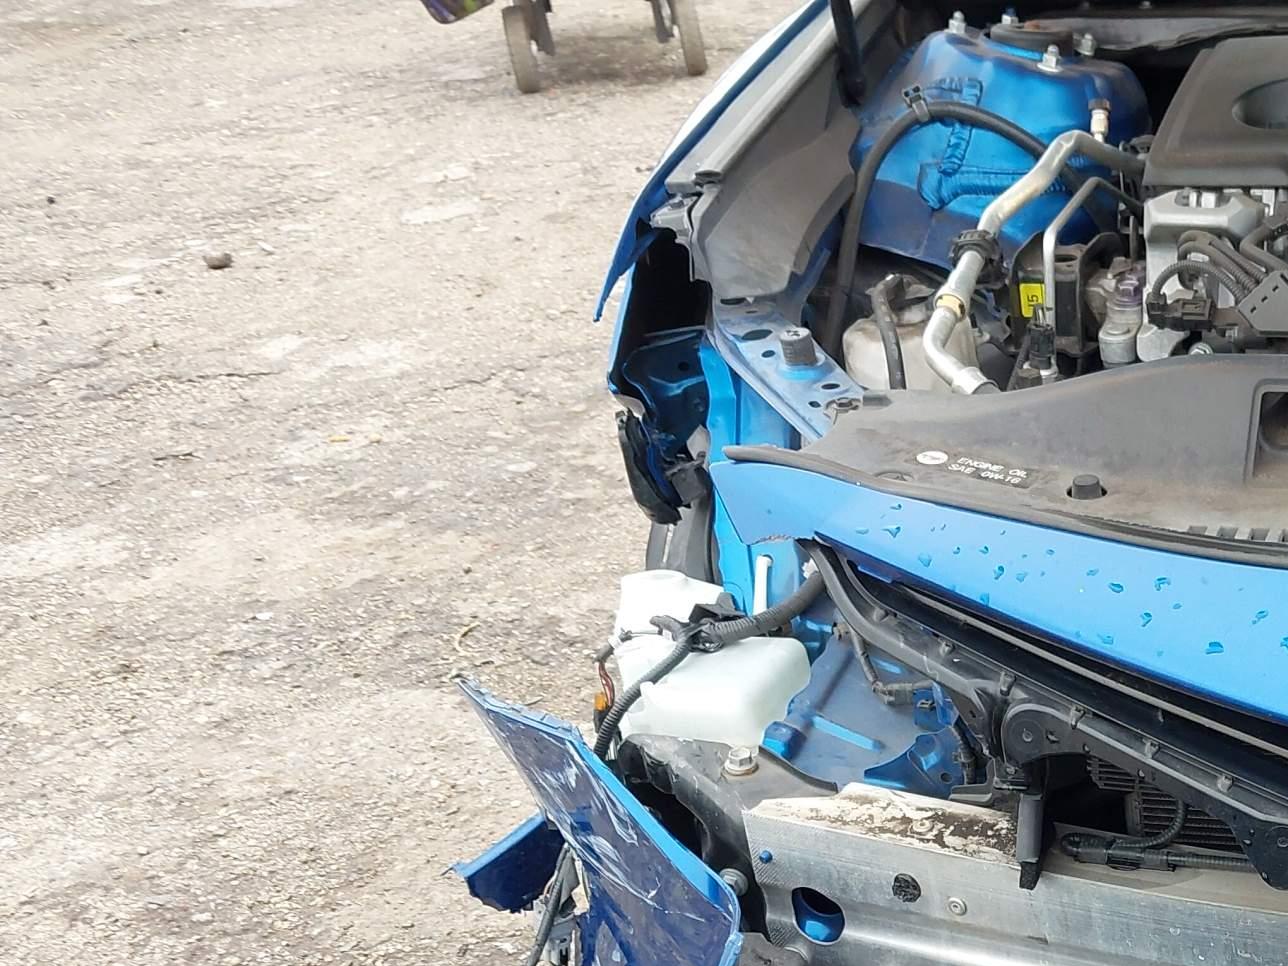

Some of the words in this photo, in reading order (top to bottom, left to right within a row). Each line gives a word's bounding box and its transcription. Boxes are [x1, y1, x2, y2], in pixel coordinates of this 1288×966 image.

[947, 463, 977, 475] SAE
[957, 457, 1005, 473] ENGINE
[1008, 468, 1028, 479] OIL
